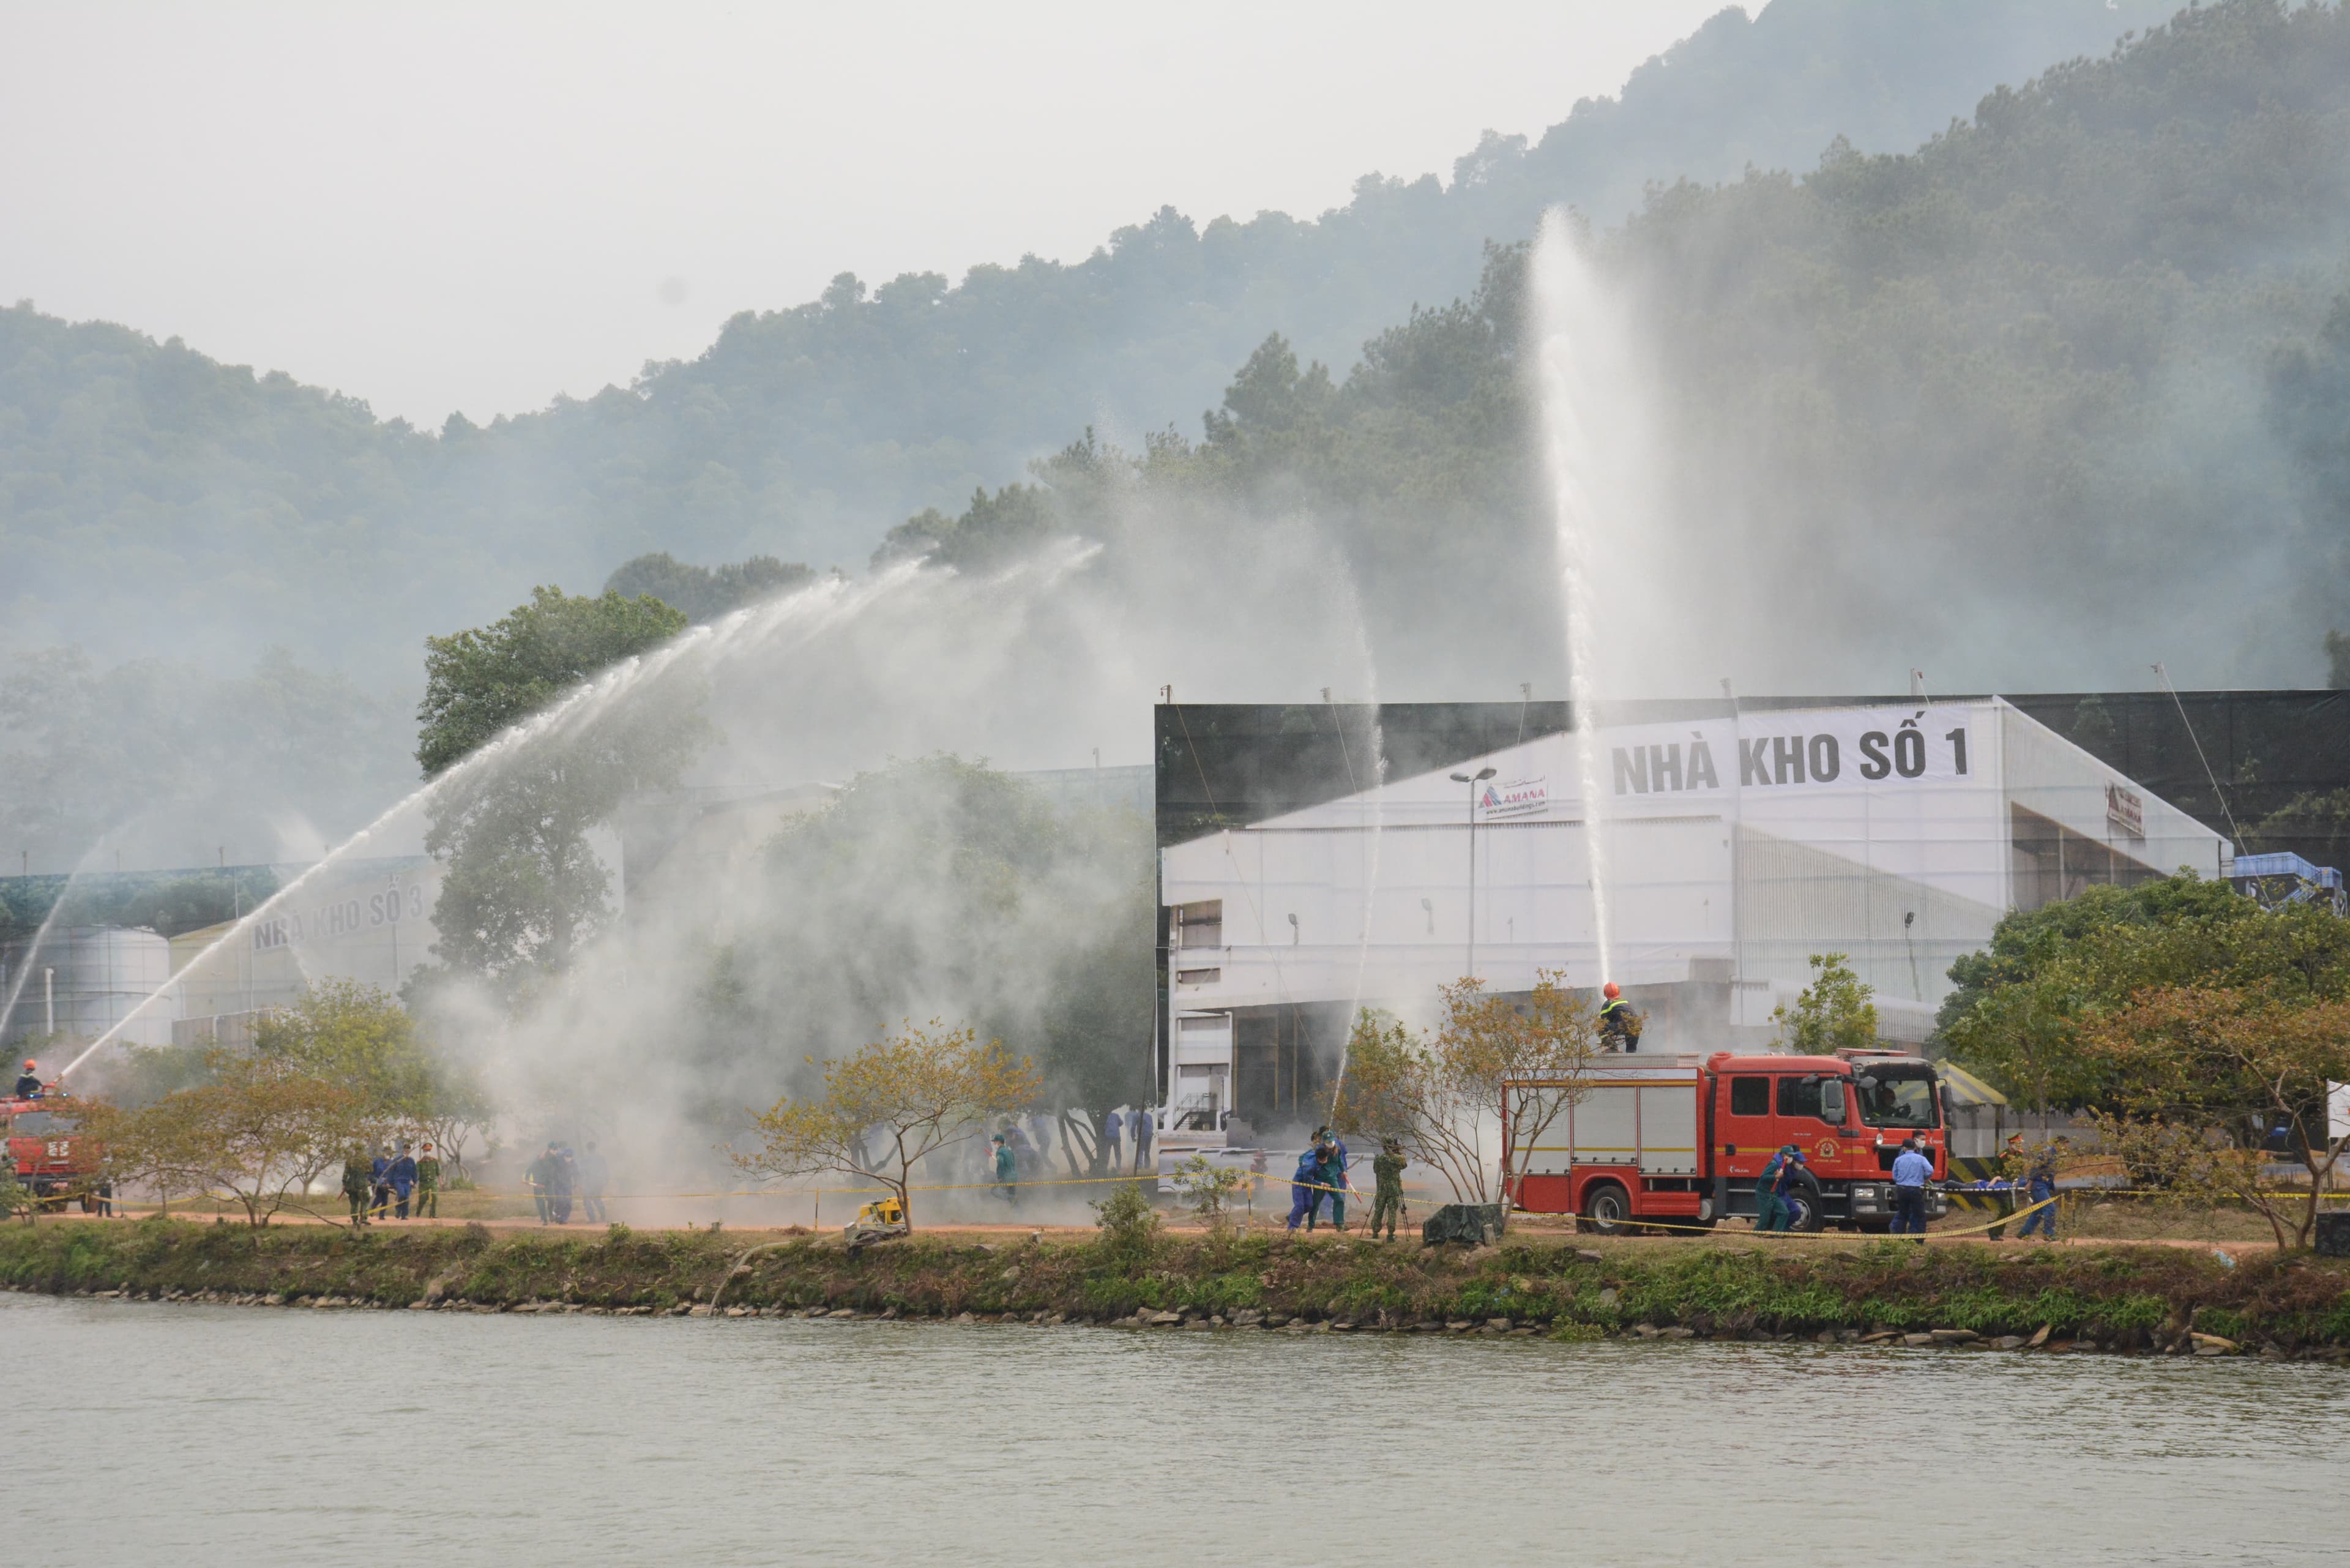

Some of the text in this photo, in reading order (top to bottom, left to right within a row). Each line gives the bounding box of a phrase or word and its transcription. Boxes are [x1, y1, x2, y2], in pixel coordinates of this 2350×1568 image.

[1611, 711, 1968, 795] NHÀ KHO SỐ 1
[1503, 788, 1546, 804] AMANA
[254, 875, 423, 950] NHÀ KHO SỐ 3
